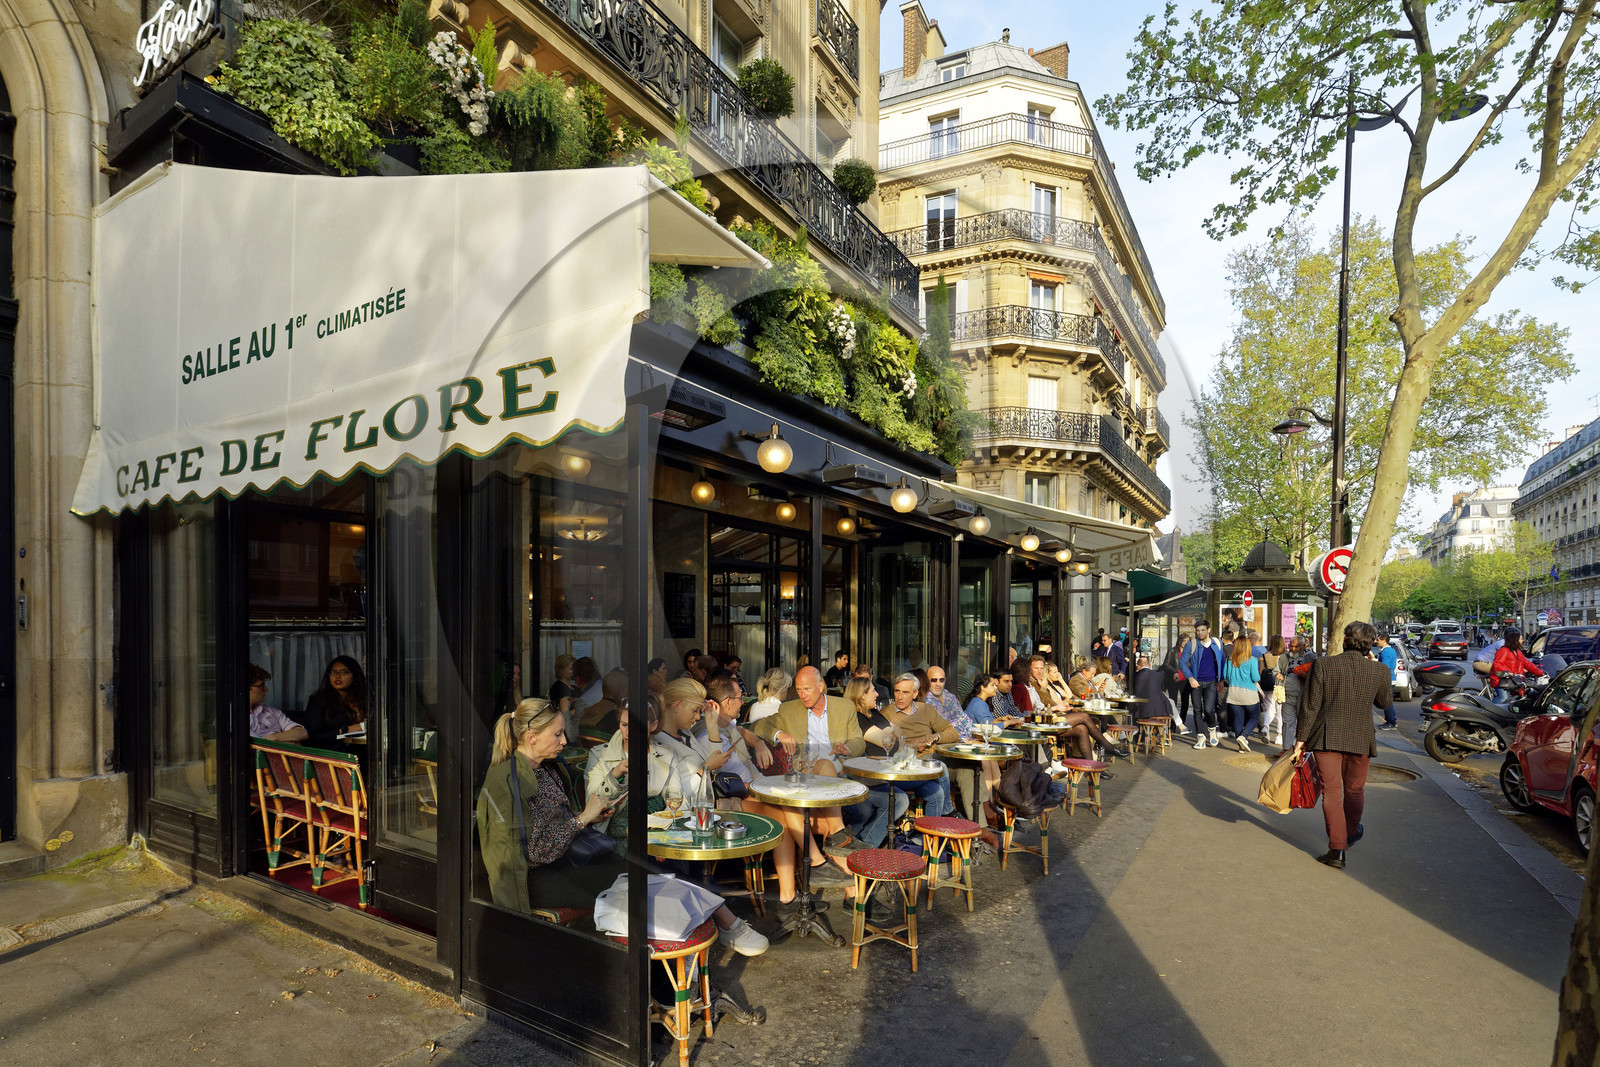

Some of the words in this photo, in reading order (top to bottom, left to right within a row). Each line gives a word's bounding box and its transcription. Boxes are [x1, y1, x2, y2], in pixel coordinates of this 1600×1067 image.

[181, 336, 241, 385] SALLE
[246, 323, 276, 364] AU
[285, 313, 308, 350] 1er
[316, 286, 406, 340] CLIMATISÉE
[116, 445, 204, 498] CAFE
[218, 429, 286, 477] DE
[303, 356, 560, 462] FLORE
